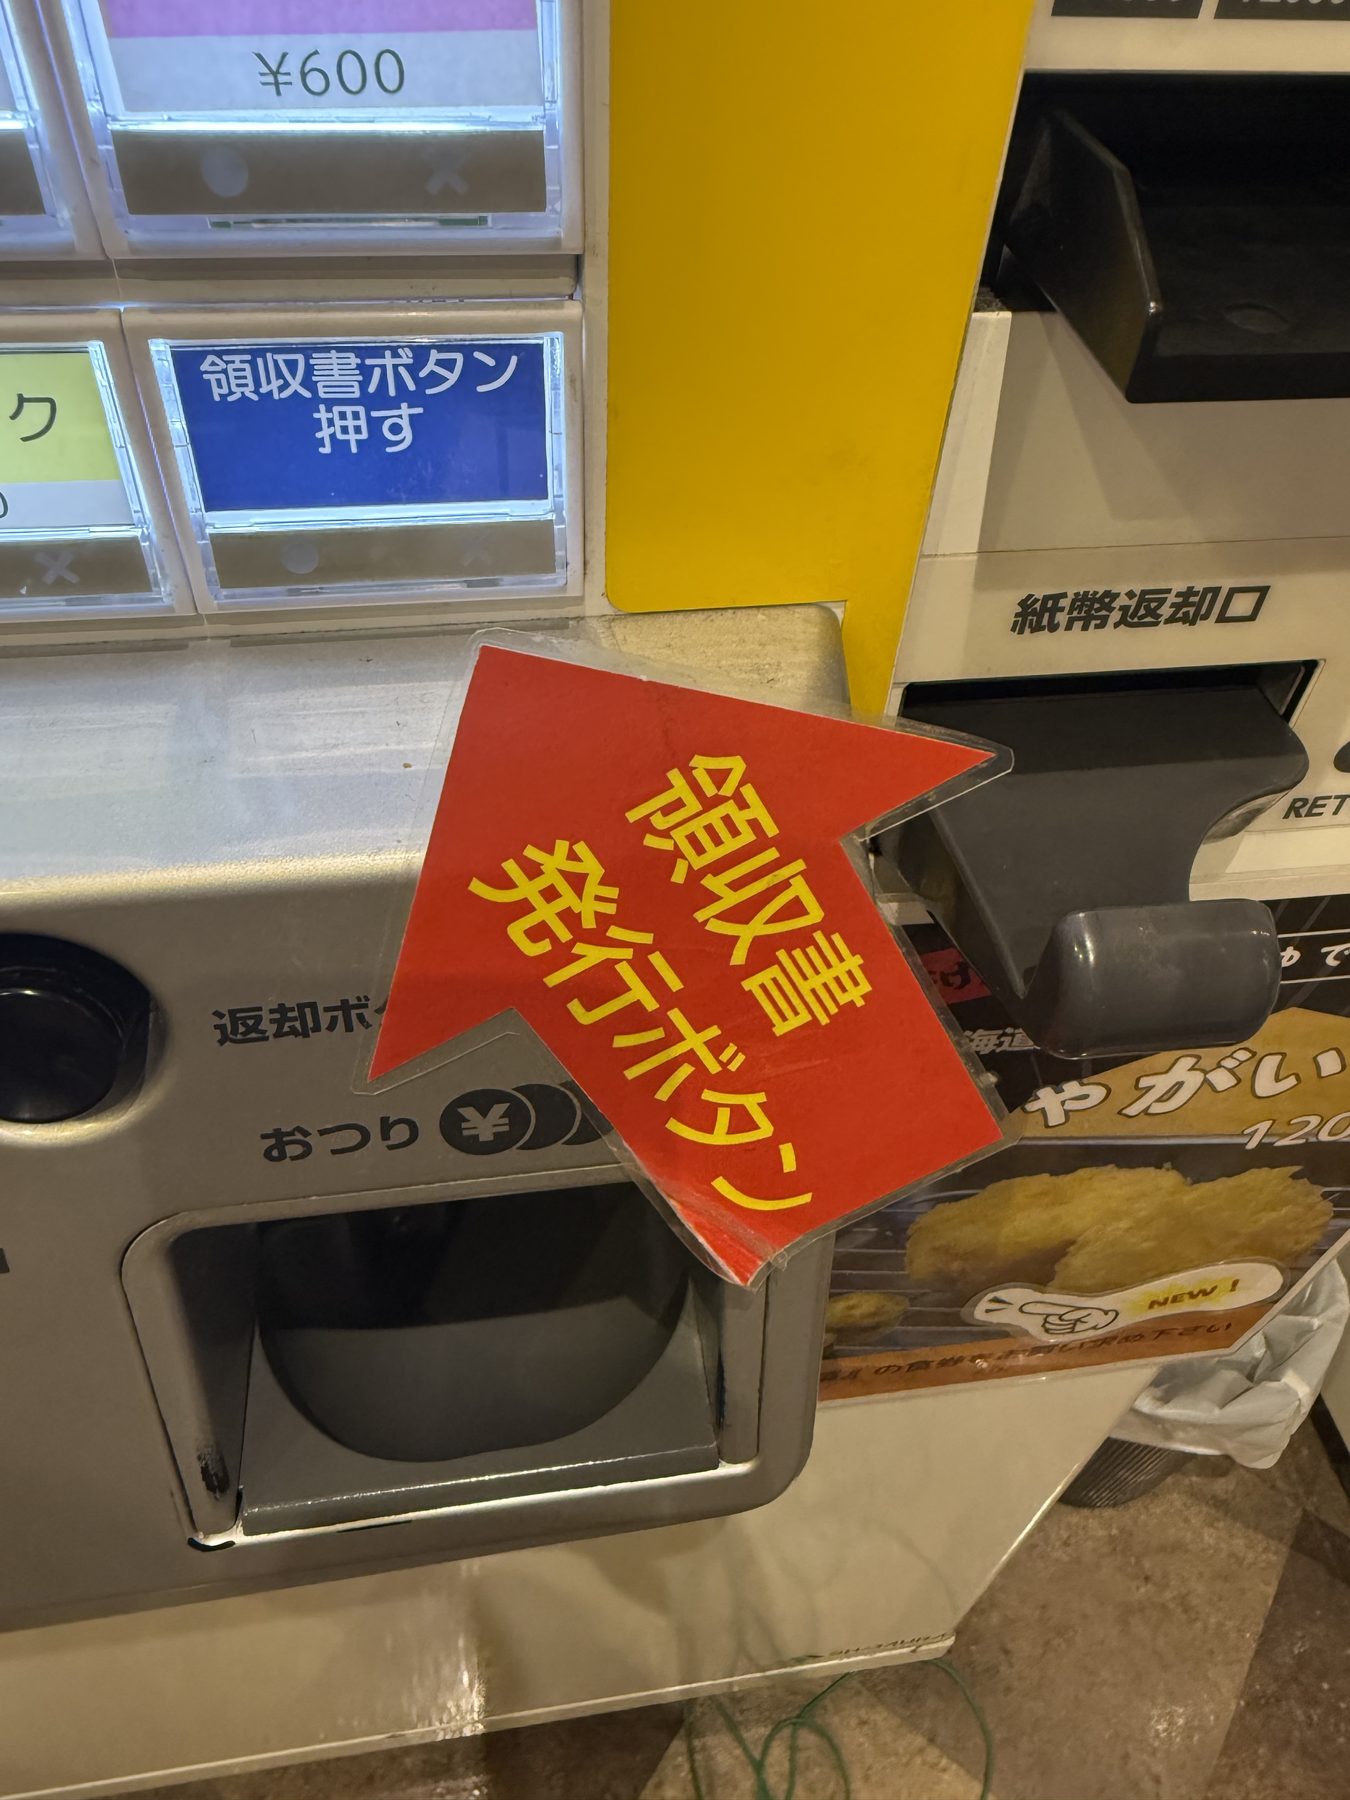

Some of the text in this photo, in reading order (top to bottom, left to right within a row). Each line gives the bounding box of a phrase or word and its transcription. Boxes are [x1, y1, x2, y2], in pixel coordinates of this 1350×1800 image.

[251, 48, 406, 98] ¥600
[199, 348, 519, 403] 領収書ボタン
[312, 402, 425, 455] 押す
[1009, 584, 1271, 637] 紙幣返却口
[625, 753, 873, 1037] 領収書
[211, 994, 387, 1047] 返却ボ
[467, 838, 814, 1212] 発行ボタン
[260, 1115, 420, 1163] おつり
